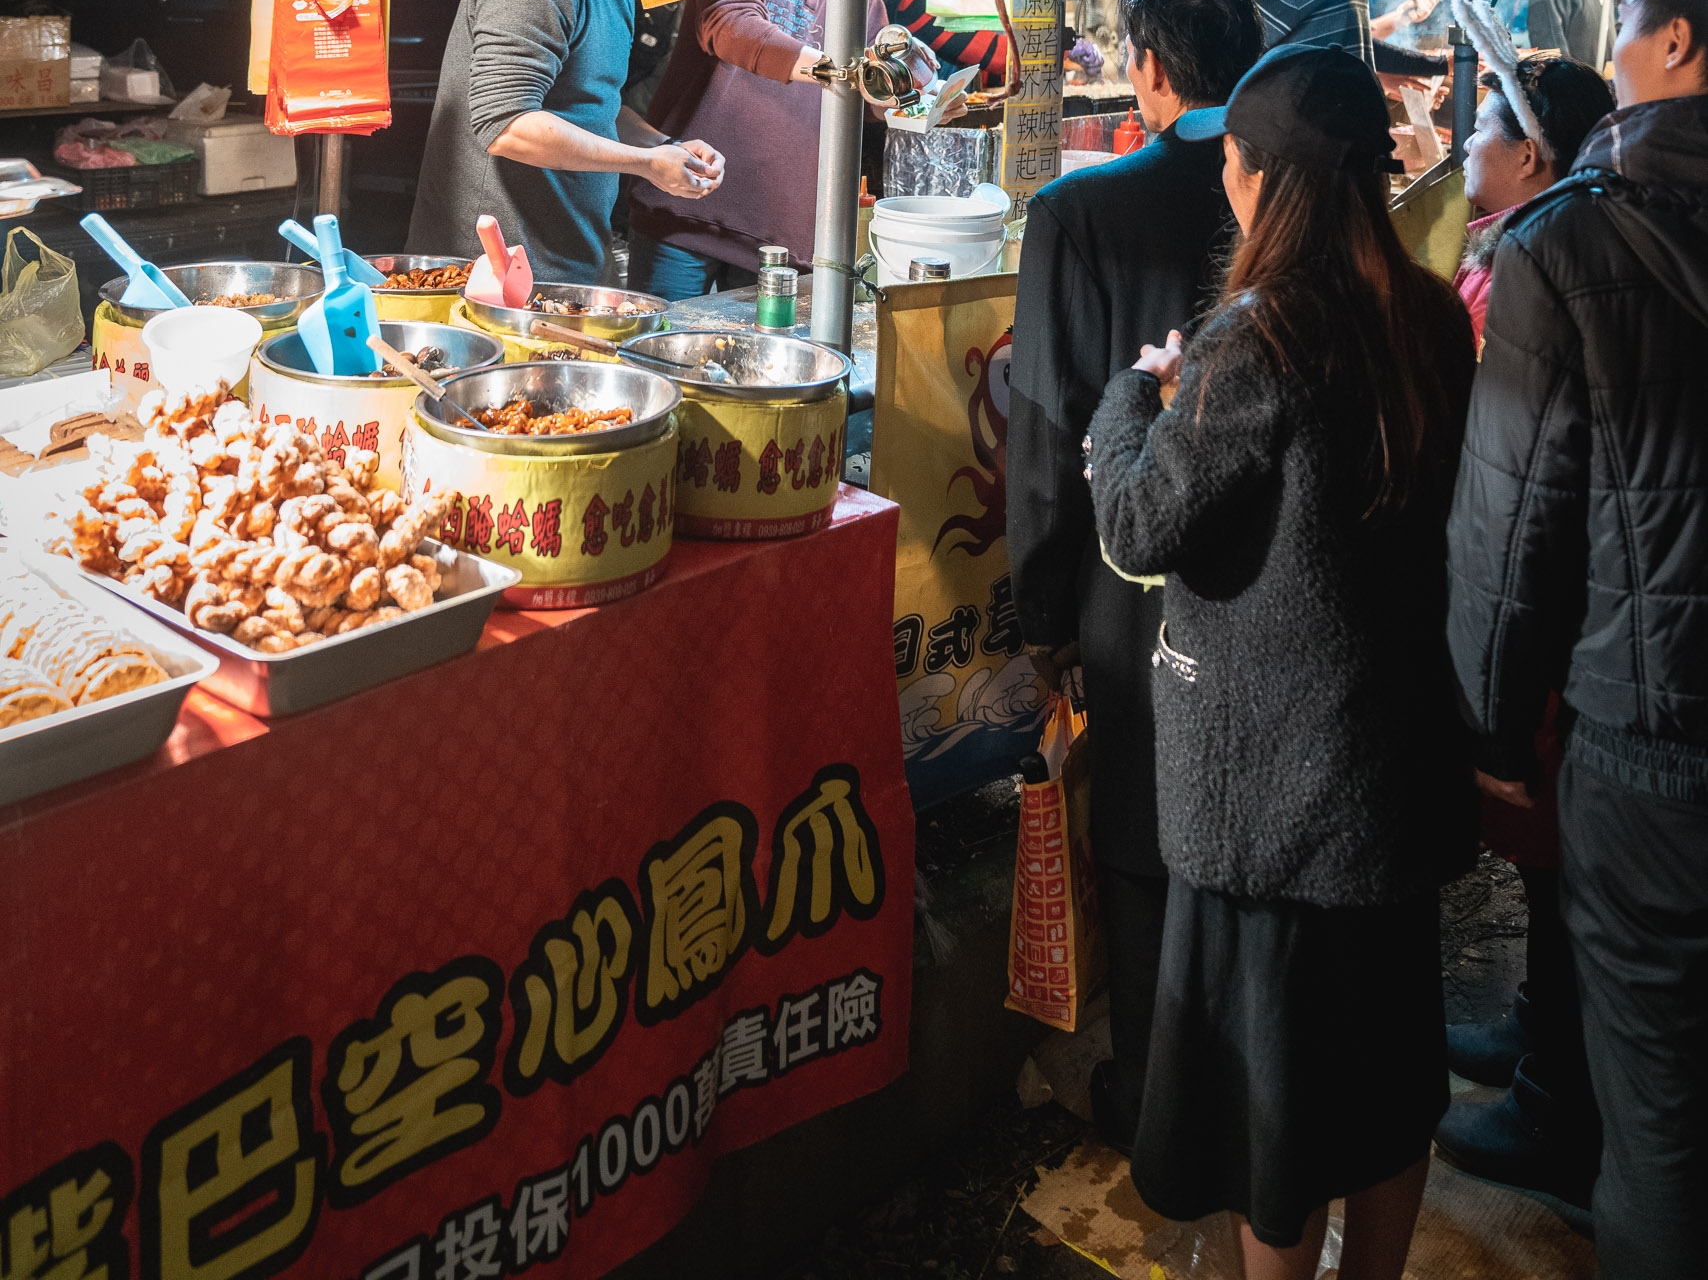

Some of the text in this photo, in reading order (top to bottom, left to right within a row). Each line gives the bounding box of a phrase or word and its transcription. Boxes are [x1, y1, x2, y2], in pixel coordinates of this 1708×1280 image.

[1021, 23, 1059, 61] 海苔
[1021, 64, 1060, 103] 芥末
[1017, 107, 1059, 145] 辣味
[1015, 145, 1058, 183] 起司
